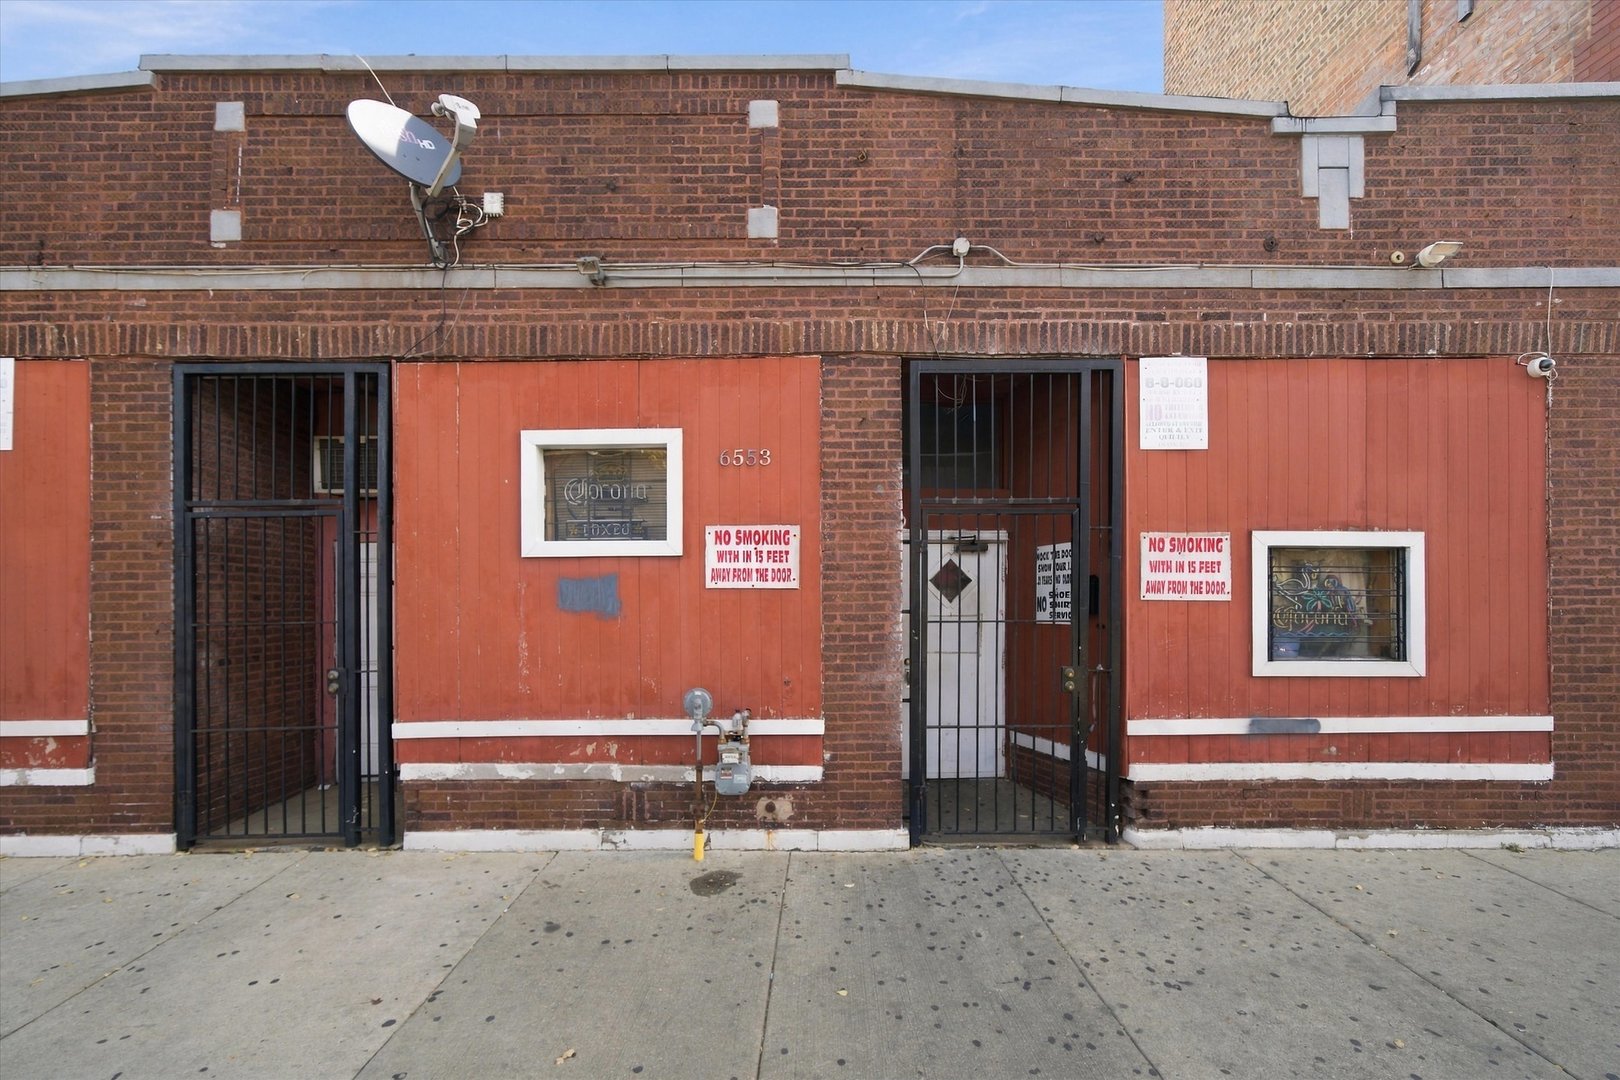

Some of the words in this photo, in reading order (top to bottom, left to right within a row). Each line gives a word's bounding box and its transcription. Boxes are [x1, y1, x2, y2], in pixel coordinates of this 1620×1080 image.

[417, 138, 436, 150] HD
[719, 448, 771, 467] 6553
[564, 478, 647, 505] Corona
[714, 530, 731, 546] NO
[735, 529, 790, 546] SMOKING
[1148, 537, 1165, 552] NO
[1169, 537, 1223, 553] SMOKING
[716, 550, 740, 563] WITH
[742, 550, 752, 563] IN
[755, 550, 764, 563] 15
[766, 550, 790, 563] FEET
[1149, 560, 1172, 573] WITH
[1175, 560, 1184, 573] IN
[1188, 561, 1196, 573] 15
[1199, 561, 1221, 573] FEET
[710, 568, 731, 583] AWAY
[732, 568, 753, 583] FROM
[755, 568, 769, 582] THE
[1145, 580, 1166, 594] AWAY
[1167, 580, 1187, 594] FROM
[1189, 581, 1203, 594] THE
[1037, 595, 1047, 613] NO
